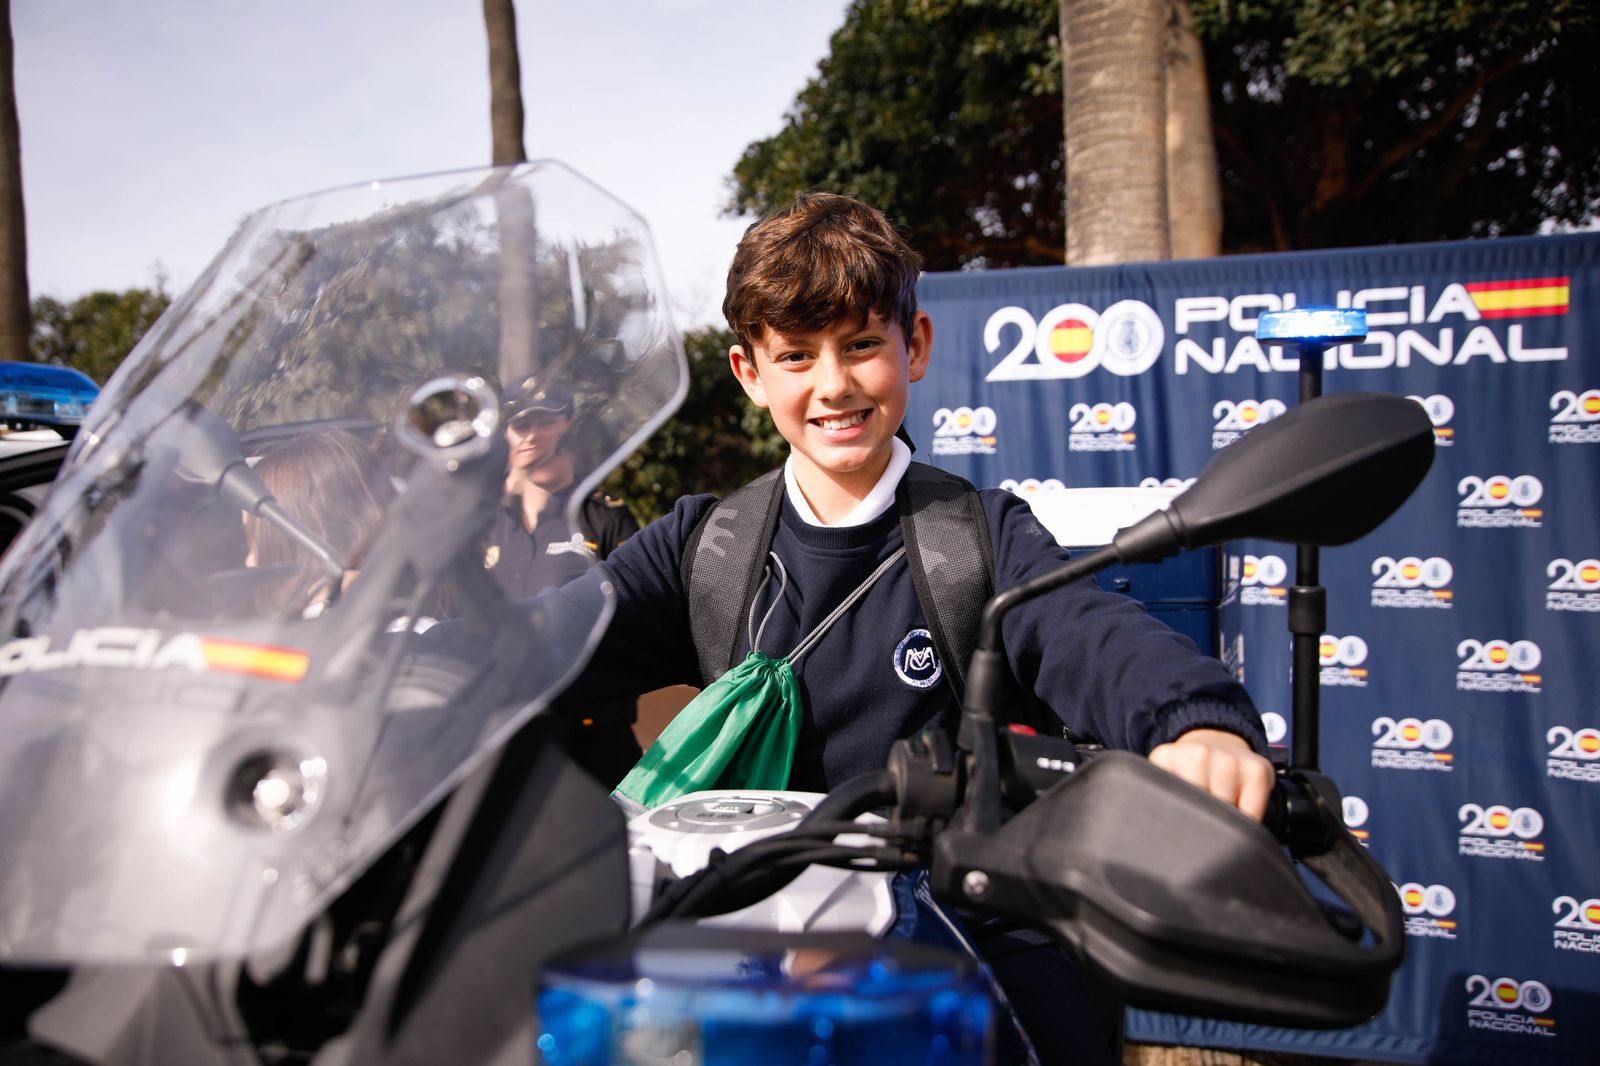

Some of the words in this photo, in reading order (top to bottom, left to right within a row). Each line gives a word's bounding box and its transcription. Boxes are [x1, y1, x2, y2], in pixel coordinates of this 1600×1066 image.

[983, 299, 1165, 382] 200
[932, 406, 997, 437] 200
[1069, 402, 1136, 432] 200
[1457, 475, 1543, 507] 200
[1371, 556, 1453, 588] 200
[1456, 639, 1542, 671] 200
[1371, 716, 1453, 750] 200
[1458, 803, 1544, 839] 200
[1465, 974, 1552, 1012] 200
